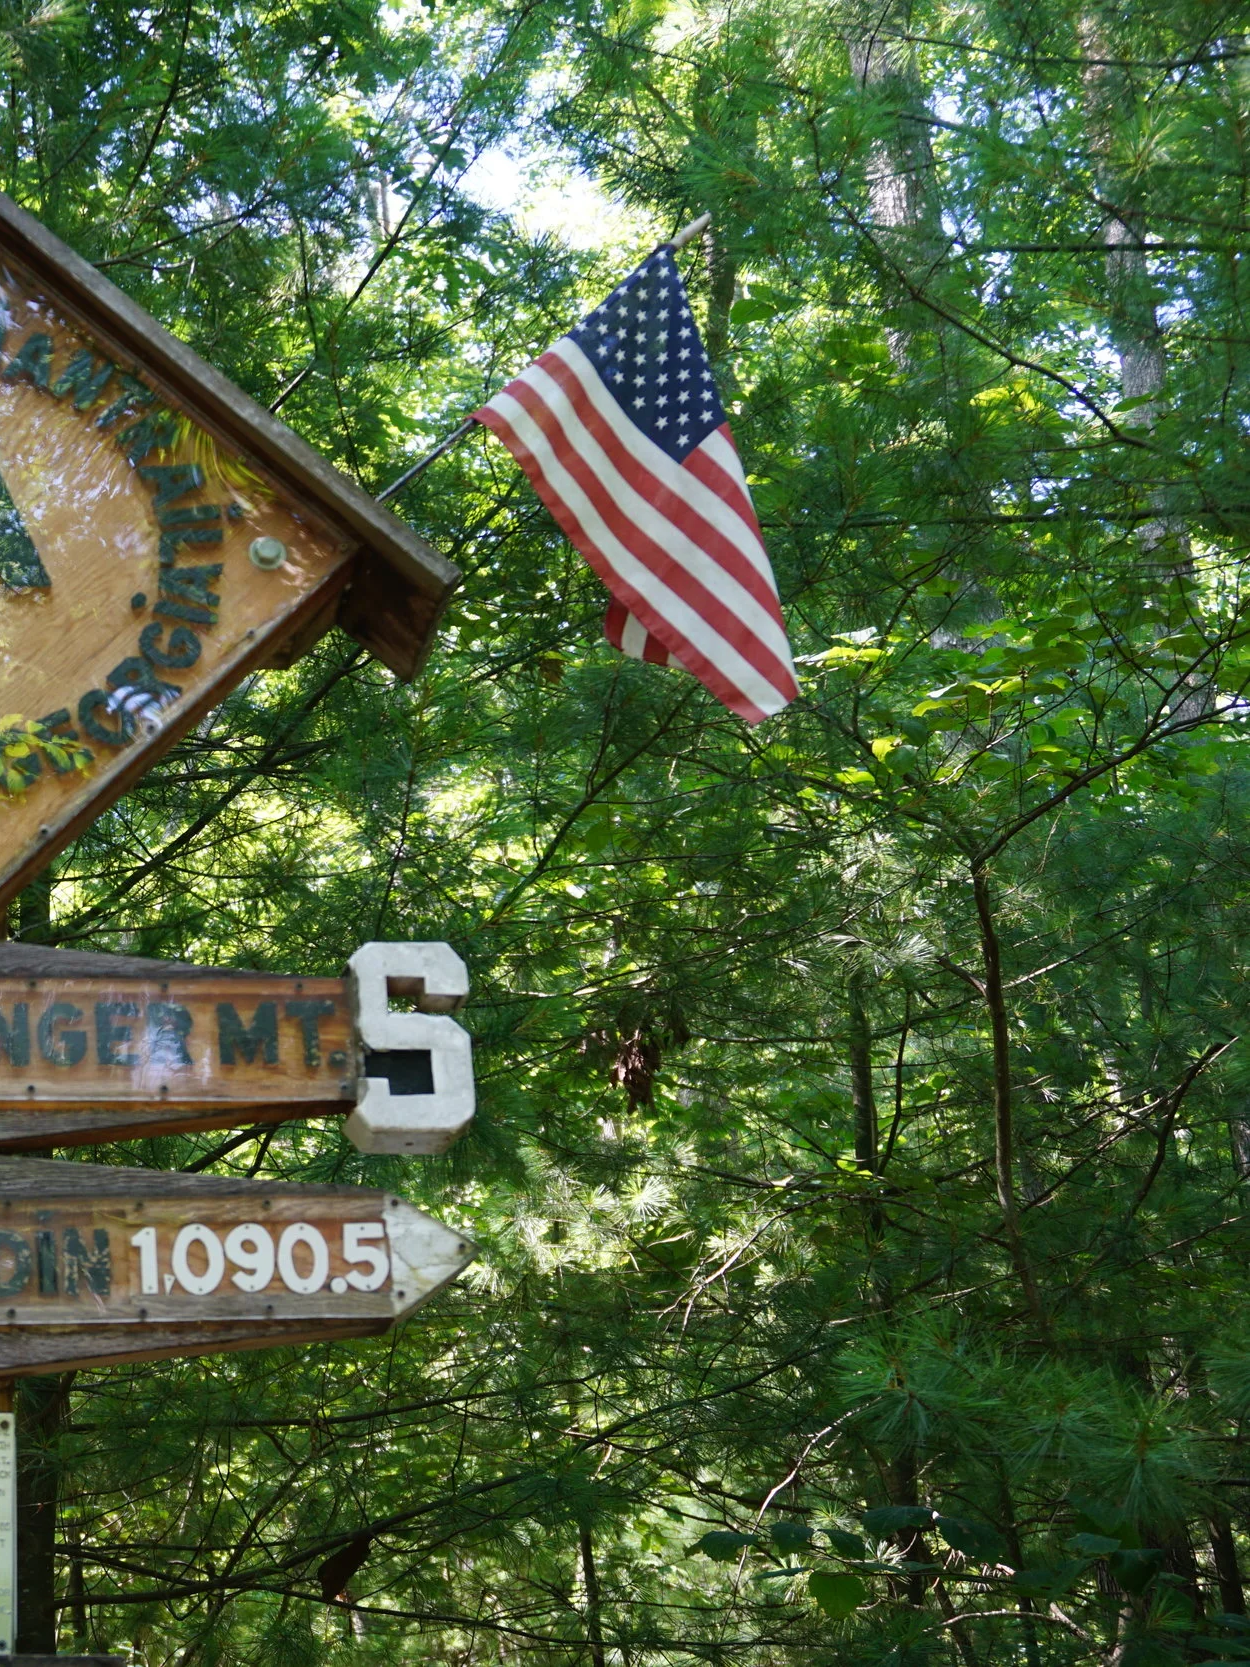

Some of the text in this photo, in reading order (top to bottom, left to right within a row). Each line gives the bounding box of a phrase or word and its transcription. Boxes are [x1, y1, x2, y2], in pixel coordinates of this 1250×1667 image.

[216, 999, 347, 1069] MT.
[348, 941, 476, 1152] S
[131, 1222, 393, 1296] 1,090.5
